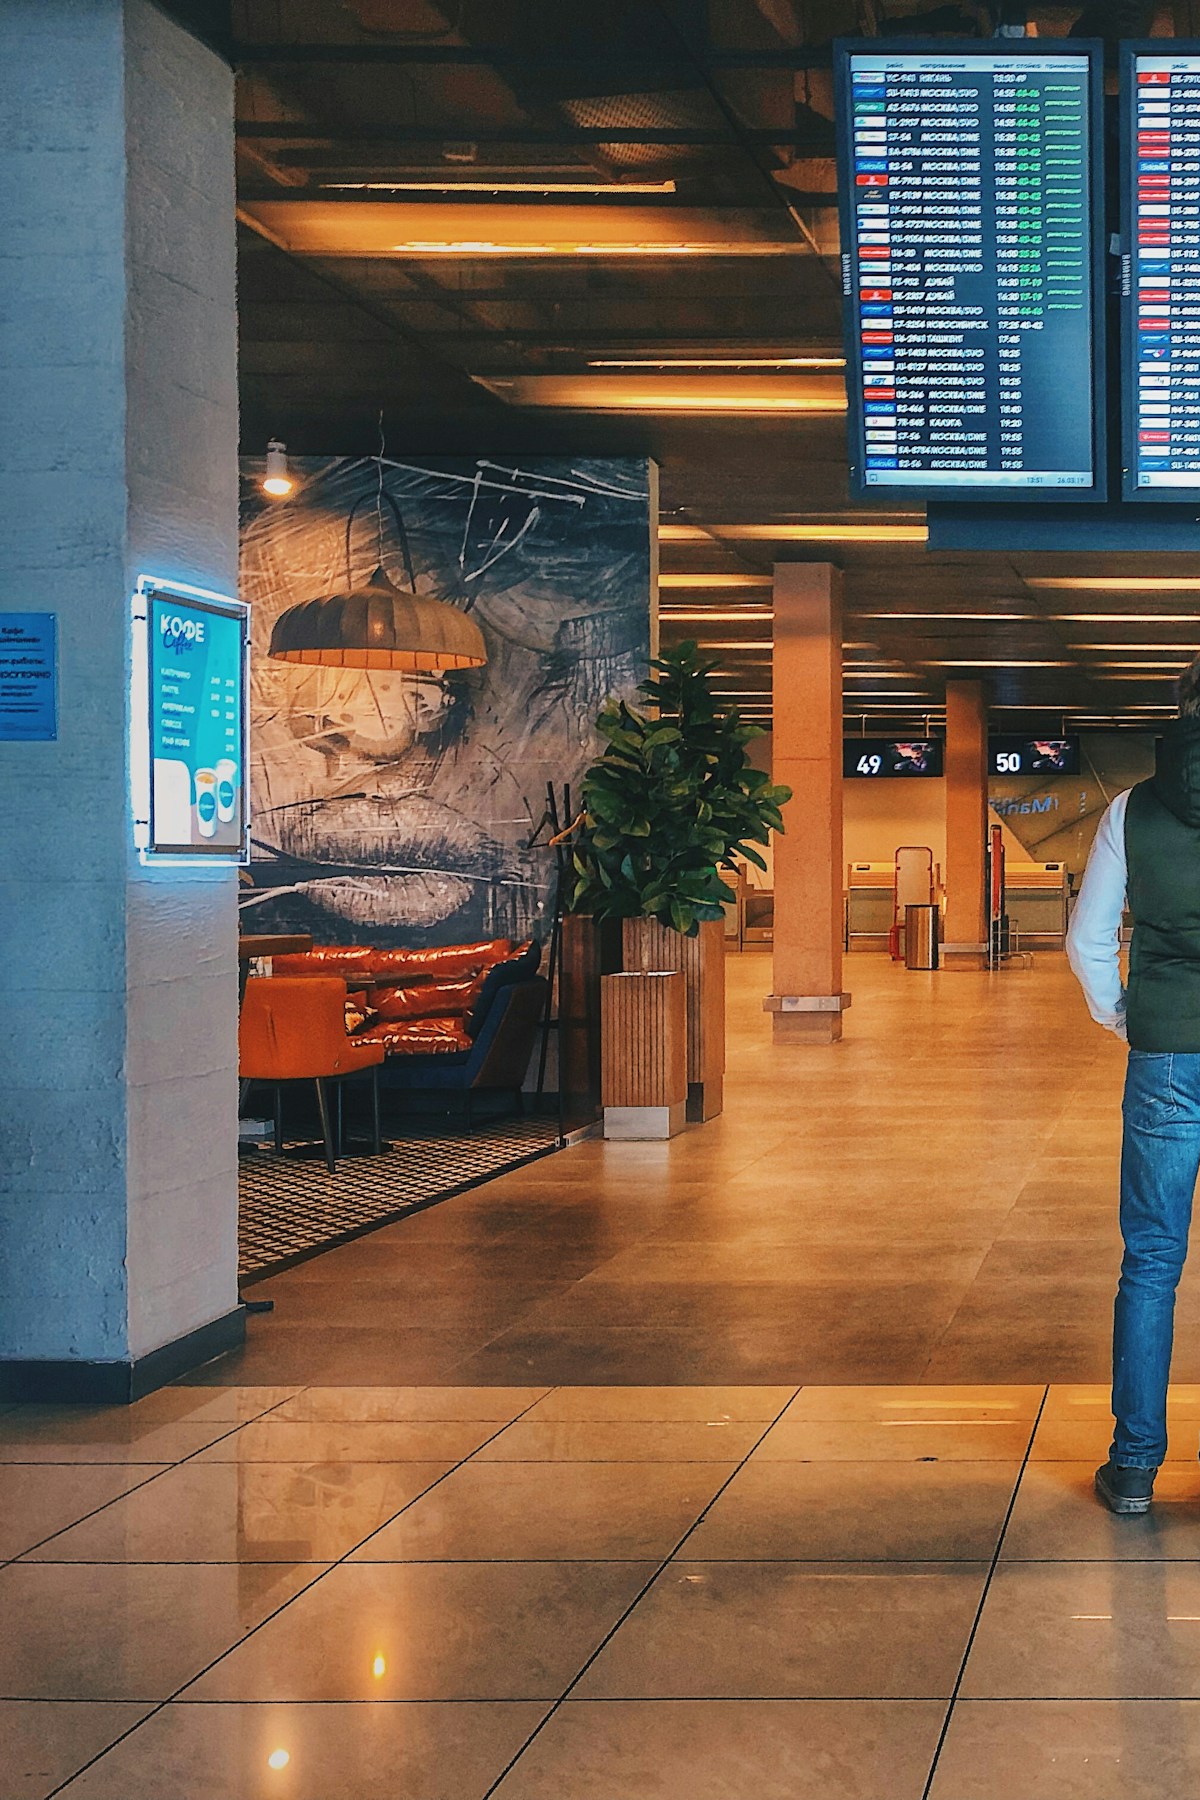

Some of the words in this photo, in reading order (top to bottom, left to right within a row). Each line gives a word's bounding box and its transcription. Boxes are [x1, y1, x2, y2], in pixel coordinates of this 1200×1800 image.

[928, 404, 987, 413] МОСКВА/DME
[929, 432, 987, 441] МОСКВА/DME
[930, 446, 988, 455] МОСКВА/DME
[930, 460, 988, 468] МОСКВА/DME
[160, 614, 205, 642] КОФЕ
[856, 754, 882, 775] 49
[996, 752, 1021, 773] 50
